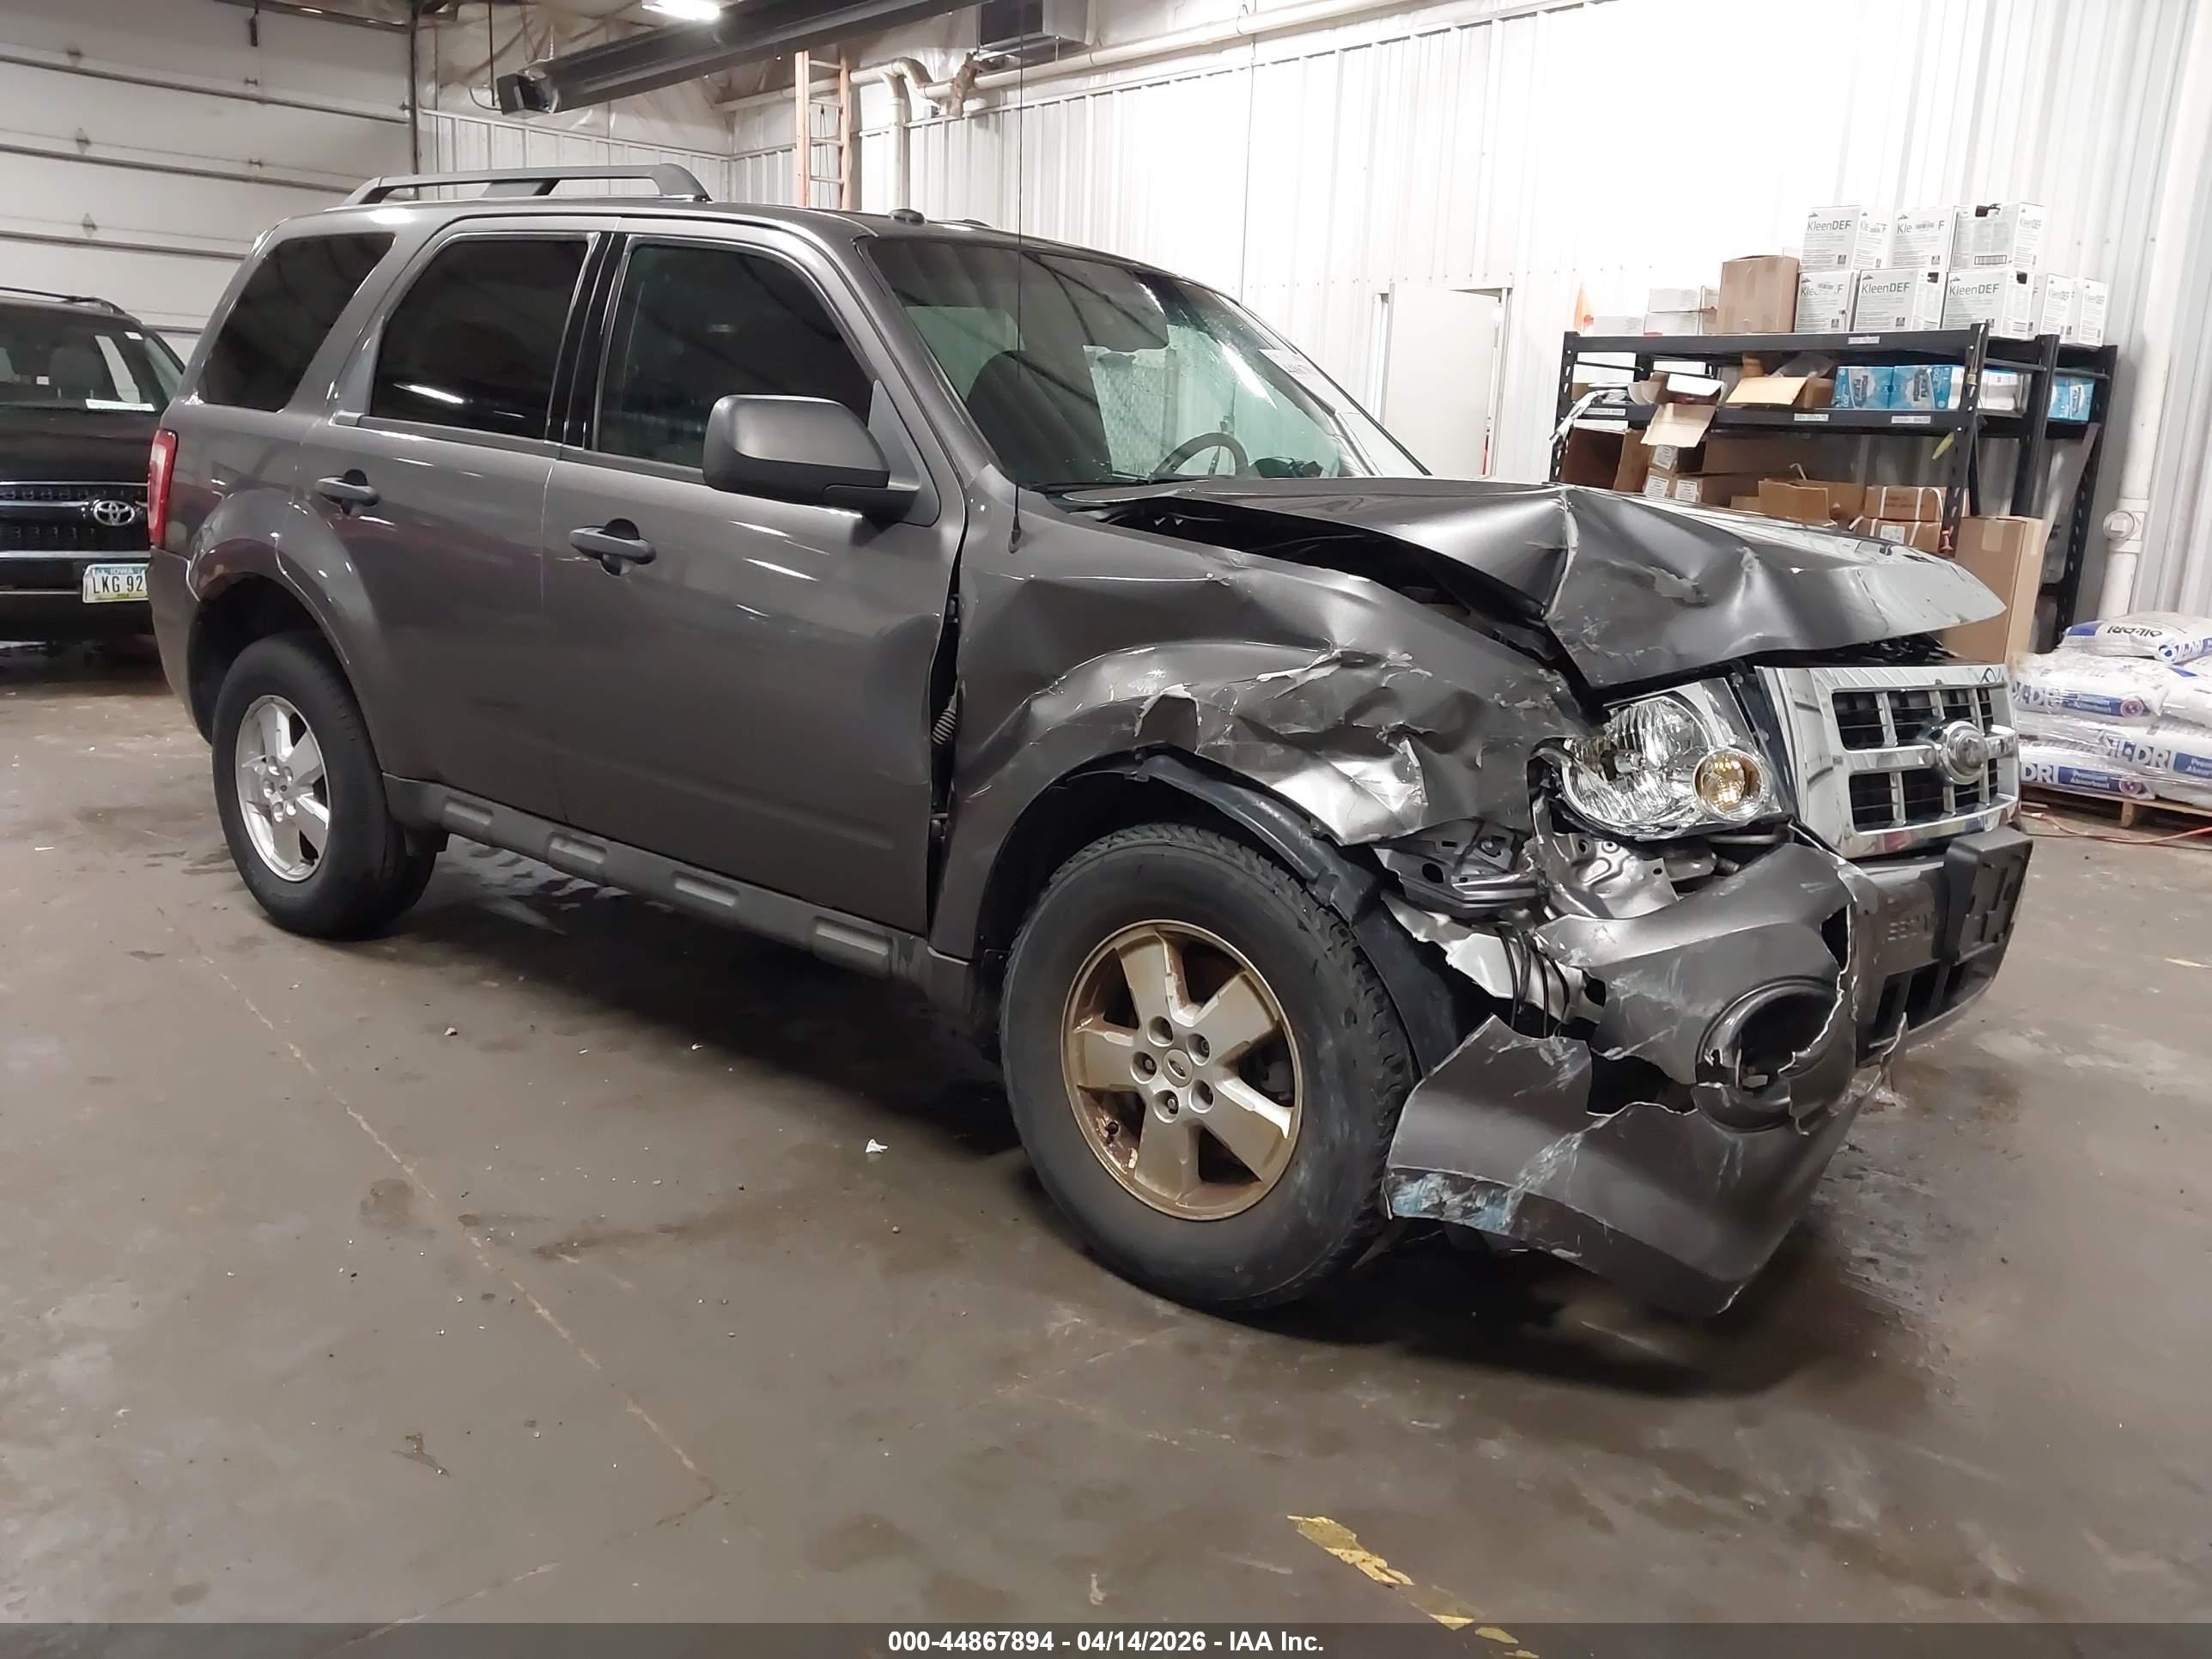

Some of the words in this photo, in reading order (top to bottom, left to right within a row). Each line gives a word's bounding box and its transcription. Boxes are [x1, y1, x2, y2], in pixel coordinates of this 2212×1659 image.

[1807, 220, 1852, 232] KleenDEF
[1861, 282, 1910, 295] KleenDEF
[1948, 283, 1999, 296] KleenDEF
[93, 575, 120, 594] LKG
[126, 575, 143, 592] 92
